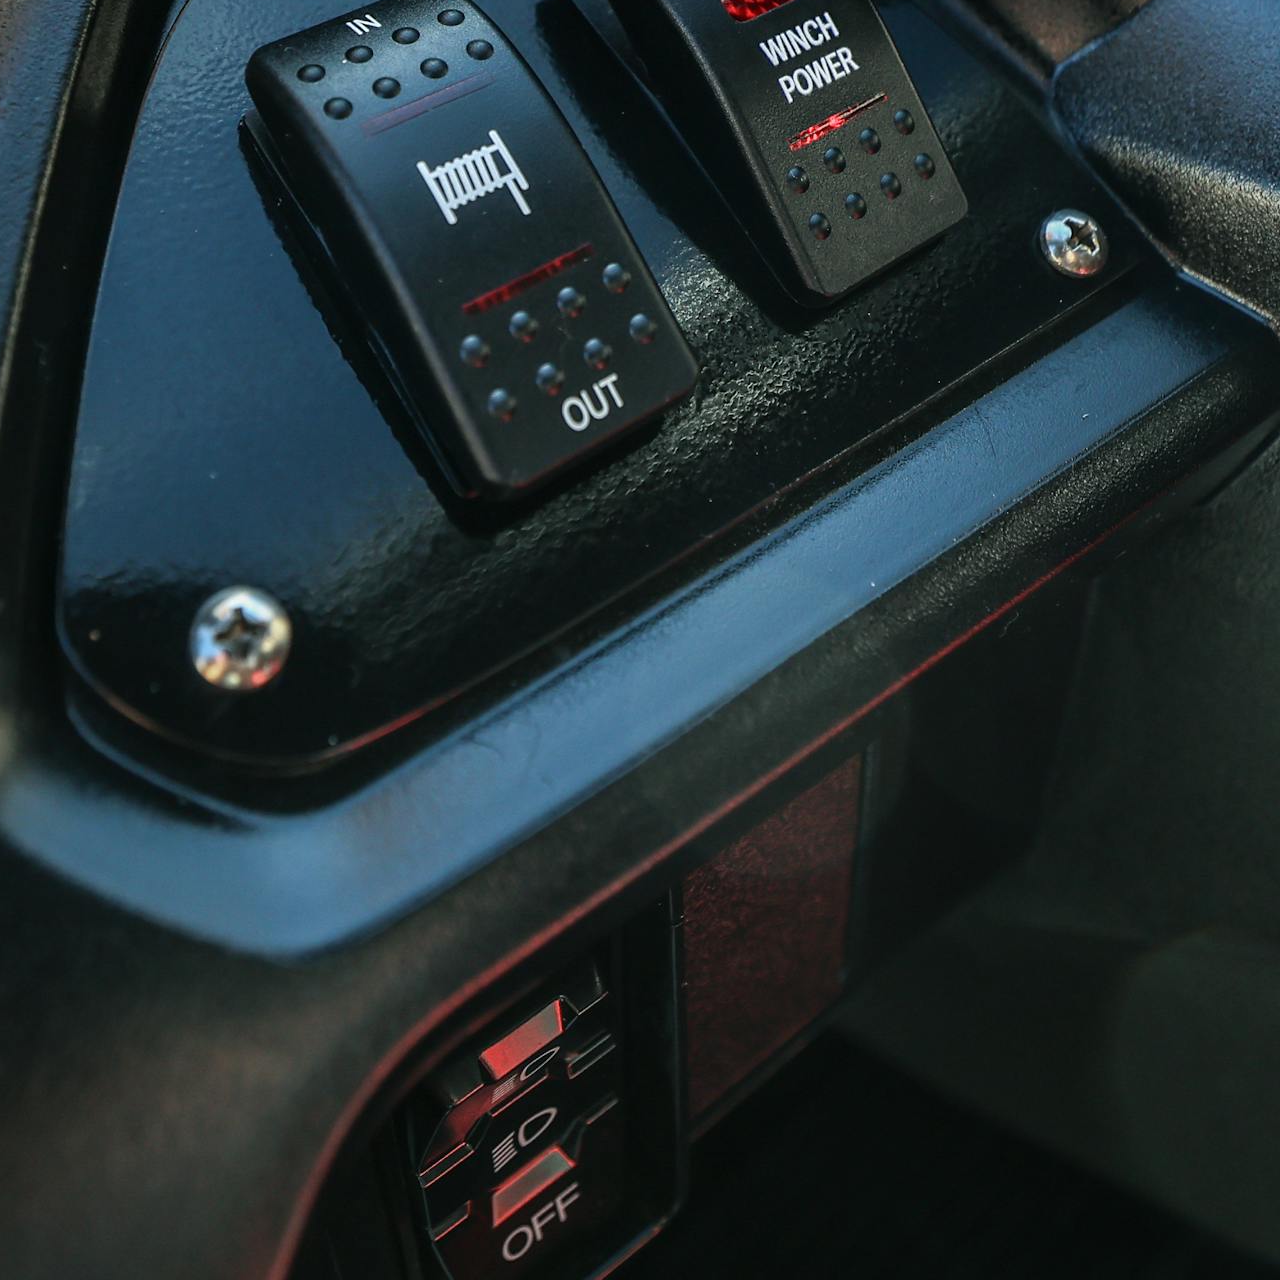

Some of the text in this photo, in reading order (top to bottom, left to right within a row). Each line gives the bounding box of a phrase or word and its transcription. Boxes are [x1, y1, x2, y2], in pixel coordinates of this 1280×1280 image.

[346, 13, 381, 36] IN
[760, 13, 840, 67] WINCH
[778, 47, 859, 103] POWER
[562, 375, 624, 431] OUT
[503, 1183, 579, 1261] OFF
